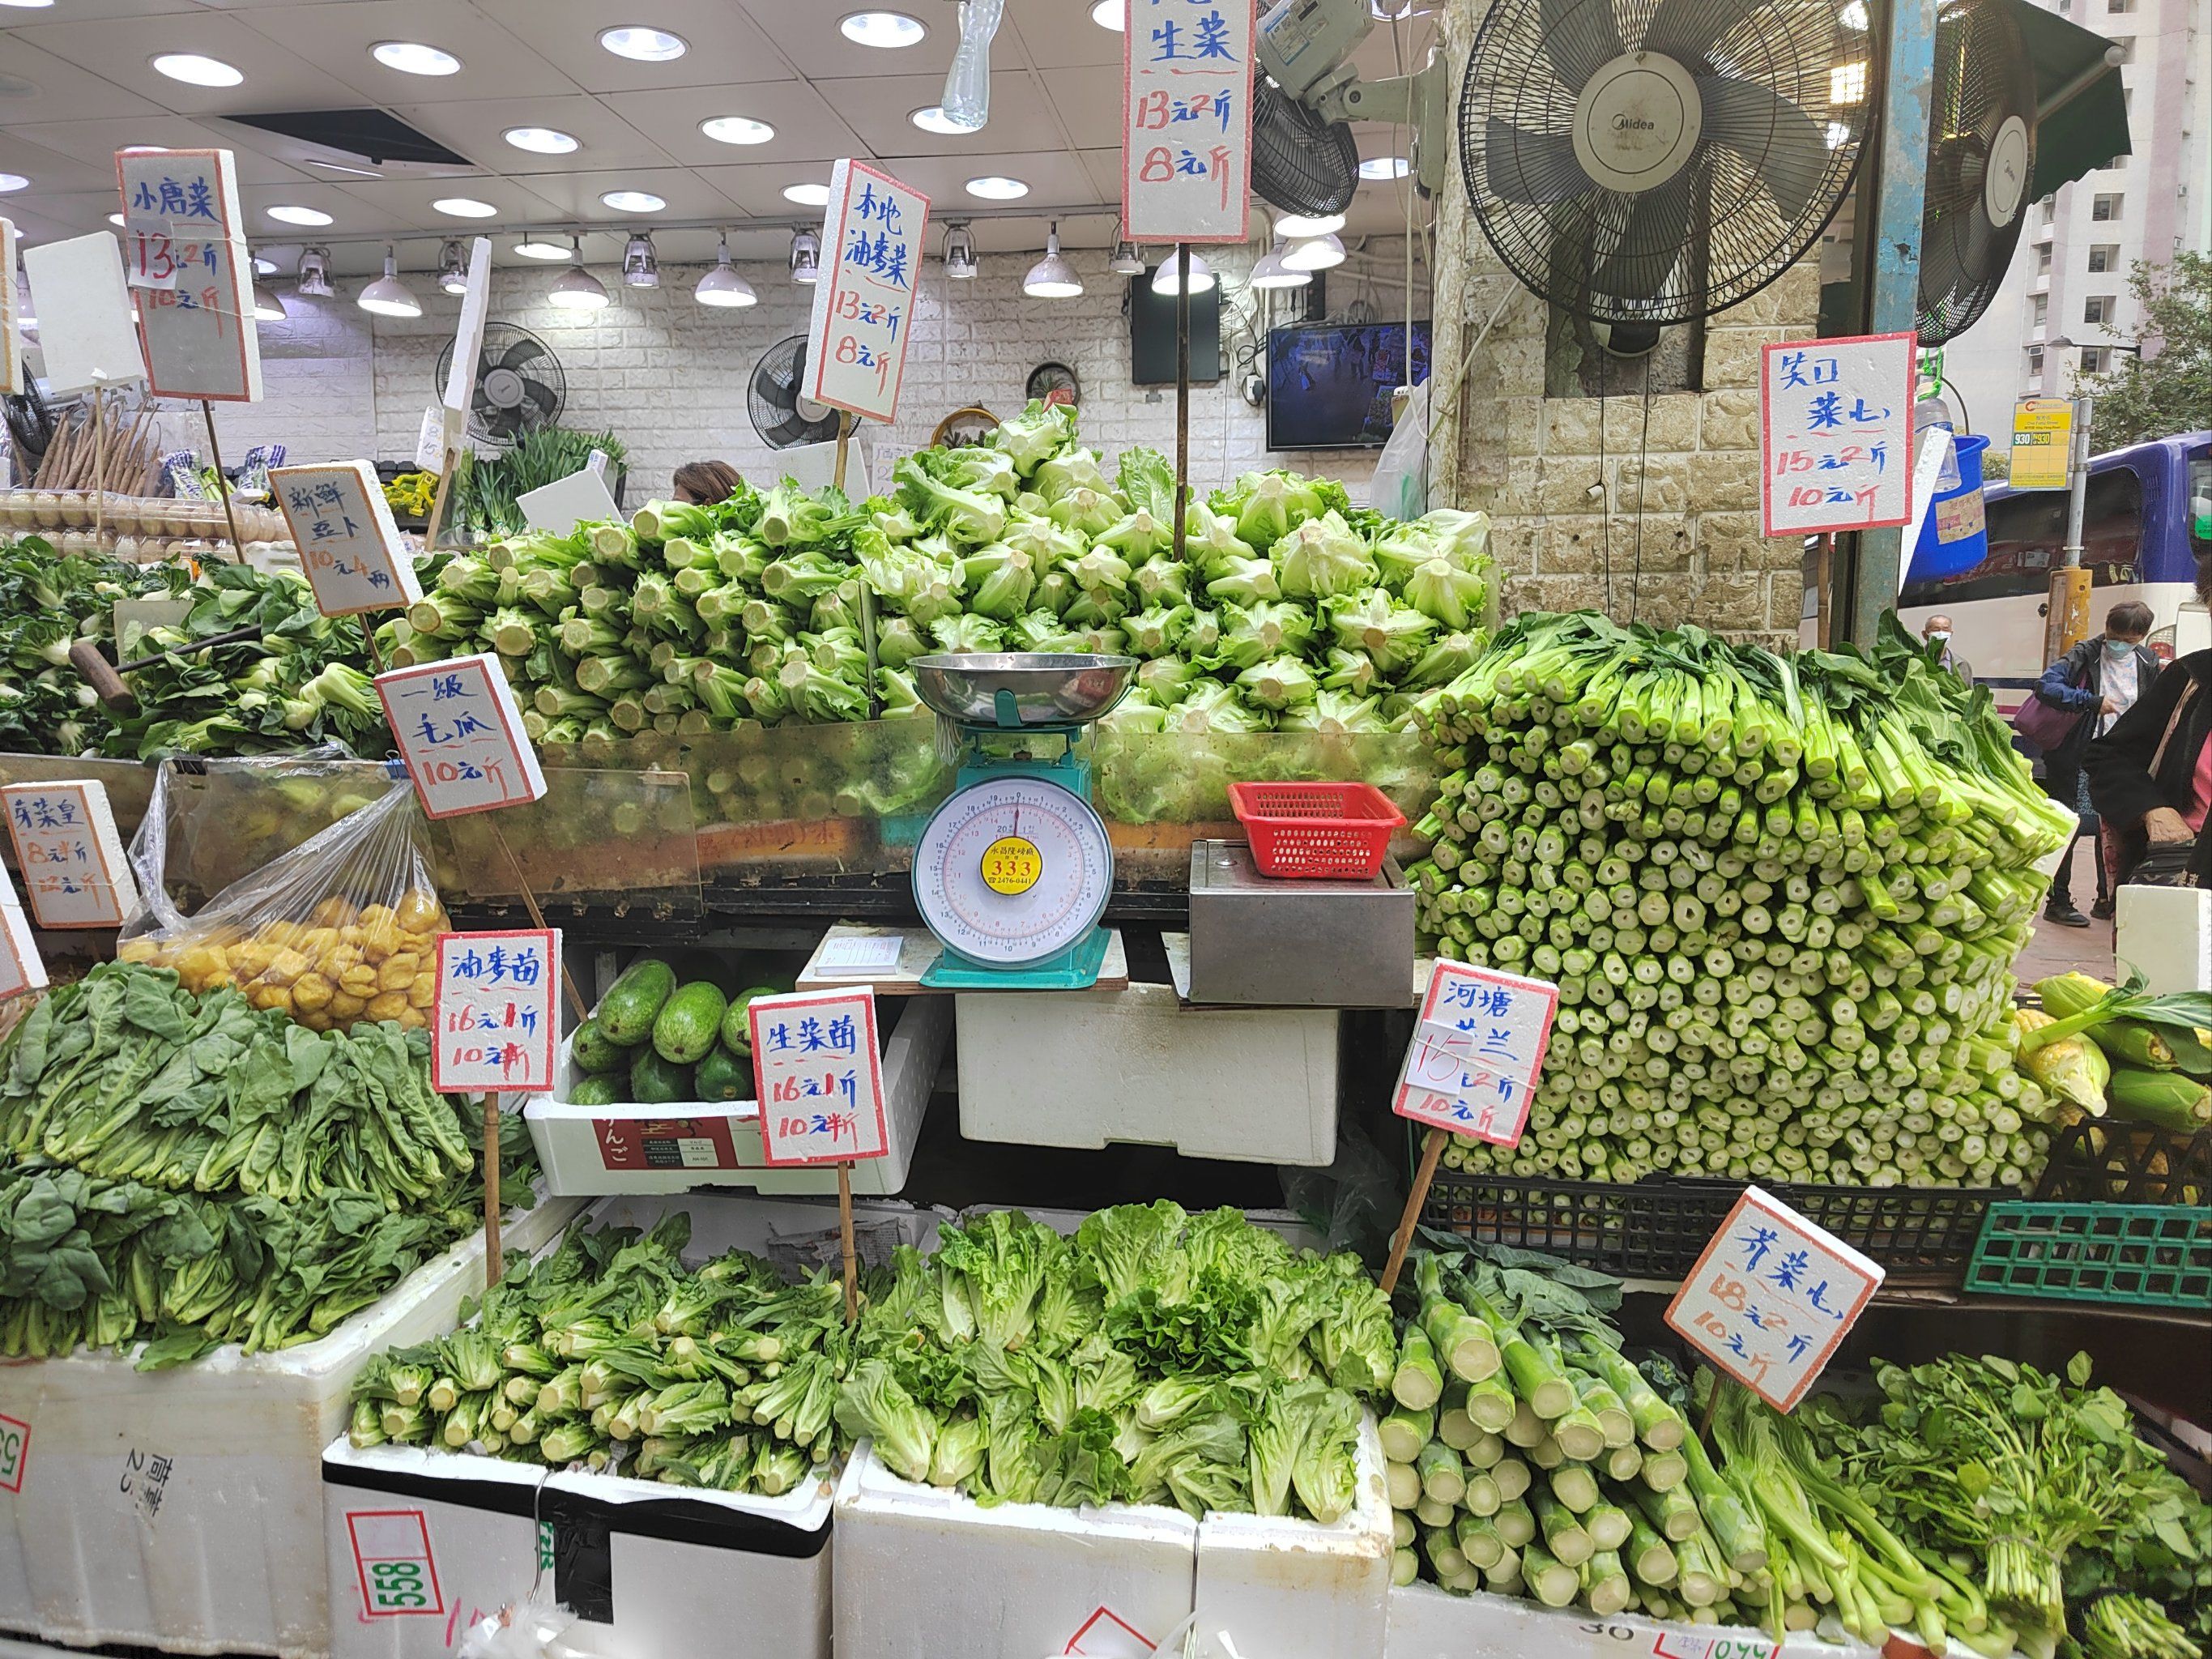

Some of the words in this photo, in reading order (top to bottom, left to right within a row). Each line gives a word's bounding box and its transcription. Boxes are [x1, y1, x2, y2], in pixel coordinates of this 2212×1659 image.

[1149, 10, 1241, 62] 生菜
[1136, 89, 1232, 134] 13元2斤
[1617, 118, 1655, 130] Midea
[1138, 145, 1233, 211] 8元斤
[134, 177, 223, 223] 小唐菜
[854, 183, 903, 236] 本地
[148, 286, 223, 338] 10元斤
[835, 290, 902, 344] 13元2斤
[835, 335, 891, 397] 8元斤
[1779, 352, 1839, 390] 笑口
[1806, 391, 1890, 429] 菜心
[1776, 441, 1888, 475] 15元2斤
[2014, 433, 2030, 444] 930
[1788, 484, 1882, 522] 10元斤
[312, 516, 360, 540] 豆卜
[401, 674, 479, 701] 一級
[412, 710, 497, 744] 毛瓜
[422, 757, 509, 800] 10元斤
[27, 841, 87, 864] 8元半斤
[991, 860, 1031, 876] 333
[1443, 981, 1513, 1017] 河塘
[448, 1002, 539, 1038] 16元1斤
[766, 1014, 856, 1055] 生菜苗
[774, 1069, 858, 1109] 16元1斤
[778, 1111, 860, 1152] 10元半斤
[1420, 1094, 1499, 1133] 10元斤
[1734, 1225, 1843, 1320] 芥菜心
[1708, 1272, 1813, 1364] 18元2斤
[1693, 1310, 1778, 1385] 10元斤
[371, 1562, 427, 1607] 558
